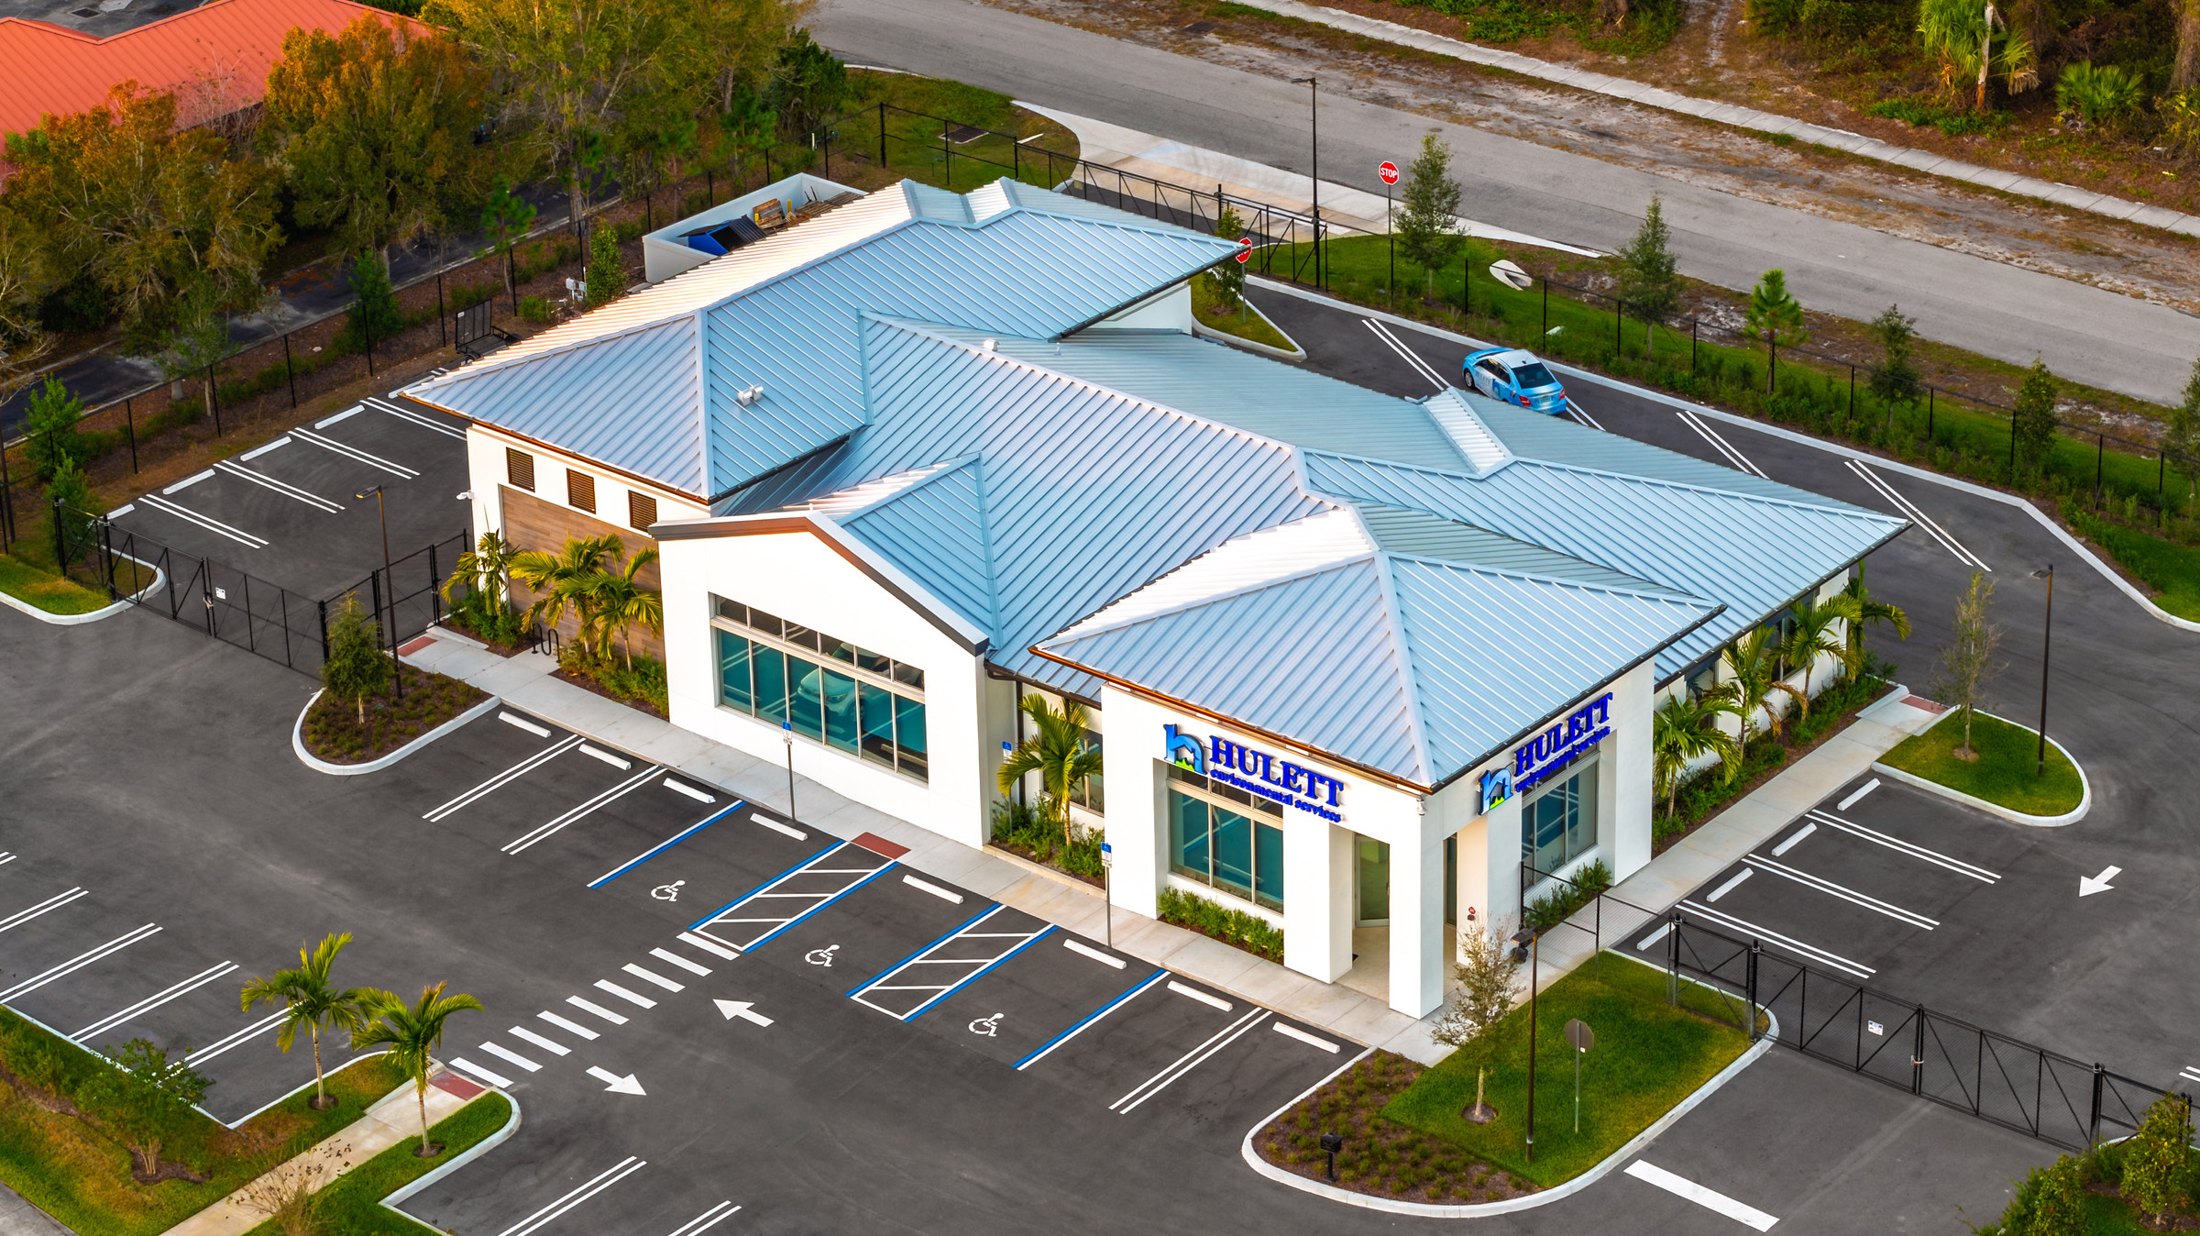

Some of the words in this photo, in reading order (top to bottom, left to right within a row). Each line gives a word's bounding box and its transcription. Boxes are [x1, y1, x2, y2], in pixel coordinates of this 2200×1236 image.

[1380, 167, 1398, 178] STOP
[1514, 692, 1613, 777] HULETT
[1209, 735, 1344, 807] HULETT
[1295, 799, 1342, 823] services
